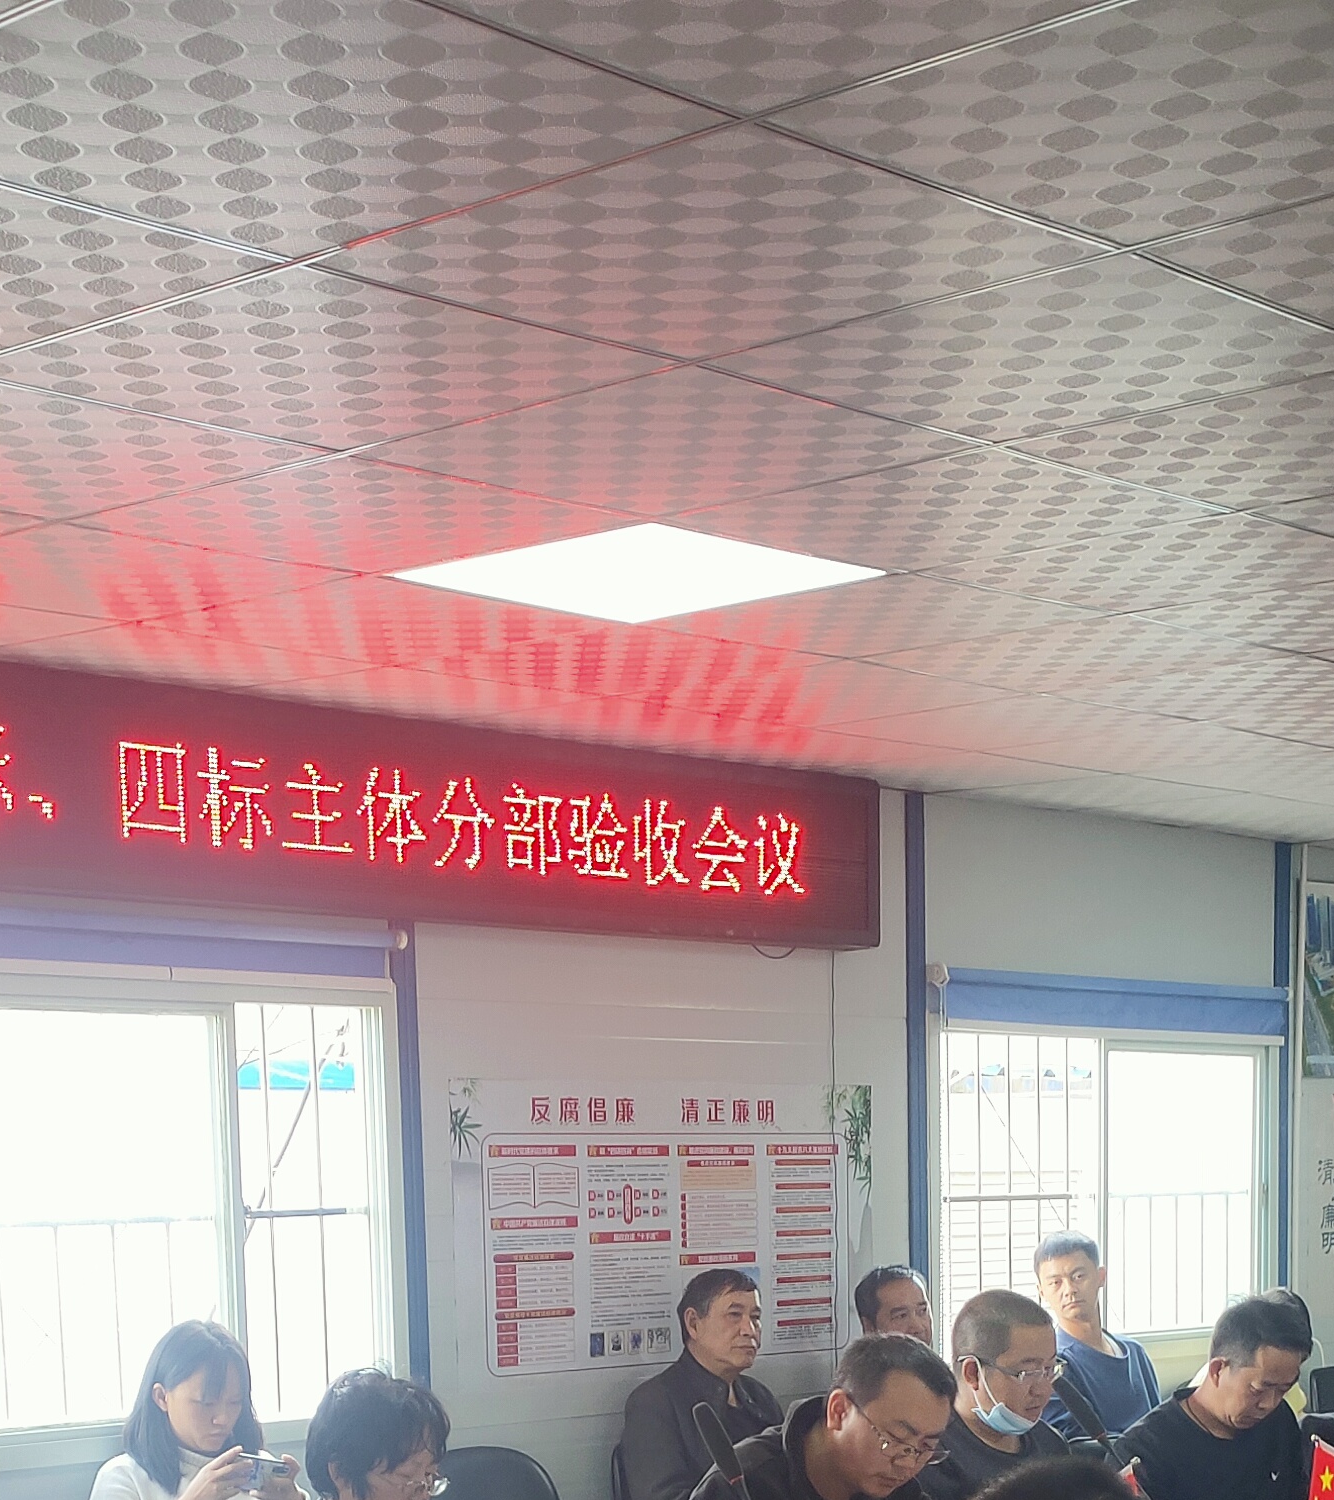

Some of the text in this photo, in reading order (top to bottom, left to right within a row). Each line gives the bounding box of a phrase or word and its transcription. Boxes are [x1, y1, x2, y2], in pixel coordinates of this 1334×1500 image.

[530, 1096, 775, 1124] 反腐倡廉 清正廉明
